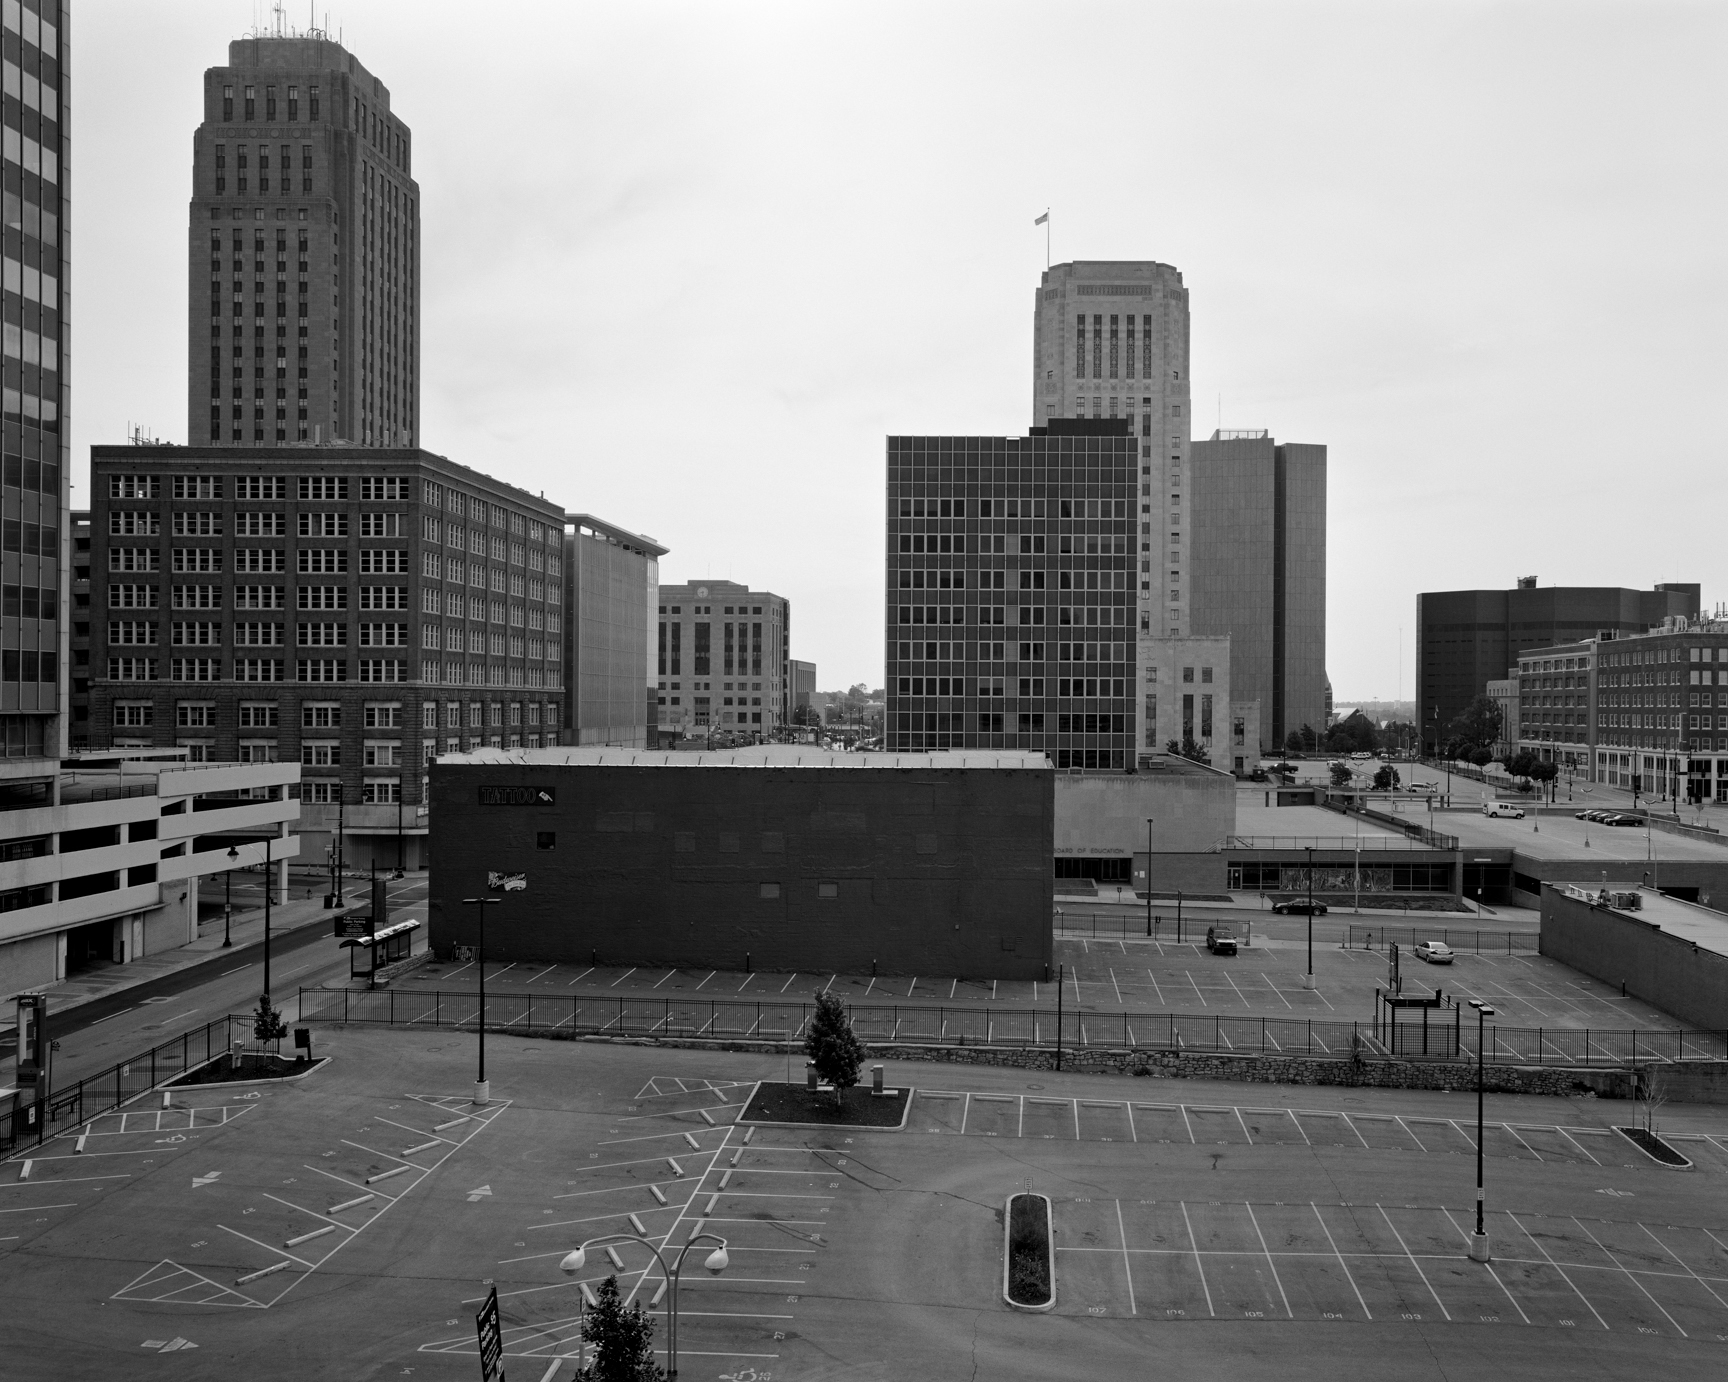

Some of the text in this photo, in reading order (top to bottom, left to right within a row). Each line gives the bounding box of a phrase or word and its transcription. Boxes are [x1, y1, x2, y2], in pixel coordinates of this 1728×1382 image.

[482, 787, 536, 804] TATTOO
[490, 873, 526, 888] Budweiser
[490, 1310, 496, 1324] $5
[480, 1322, 490, 1340] Public
[481, 1329, 493, 1350] Parking
[759, 1372, 771, 1381] 26
